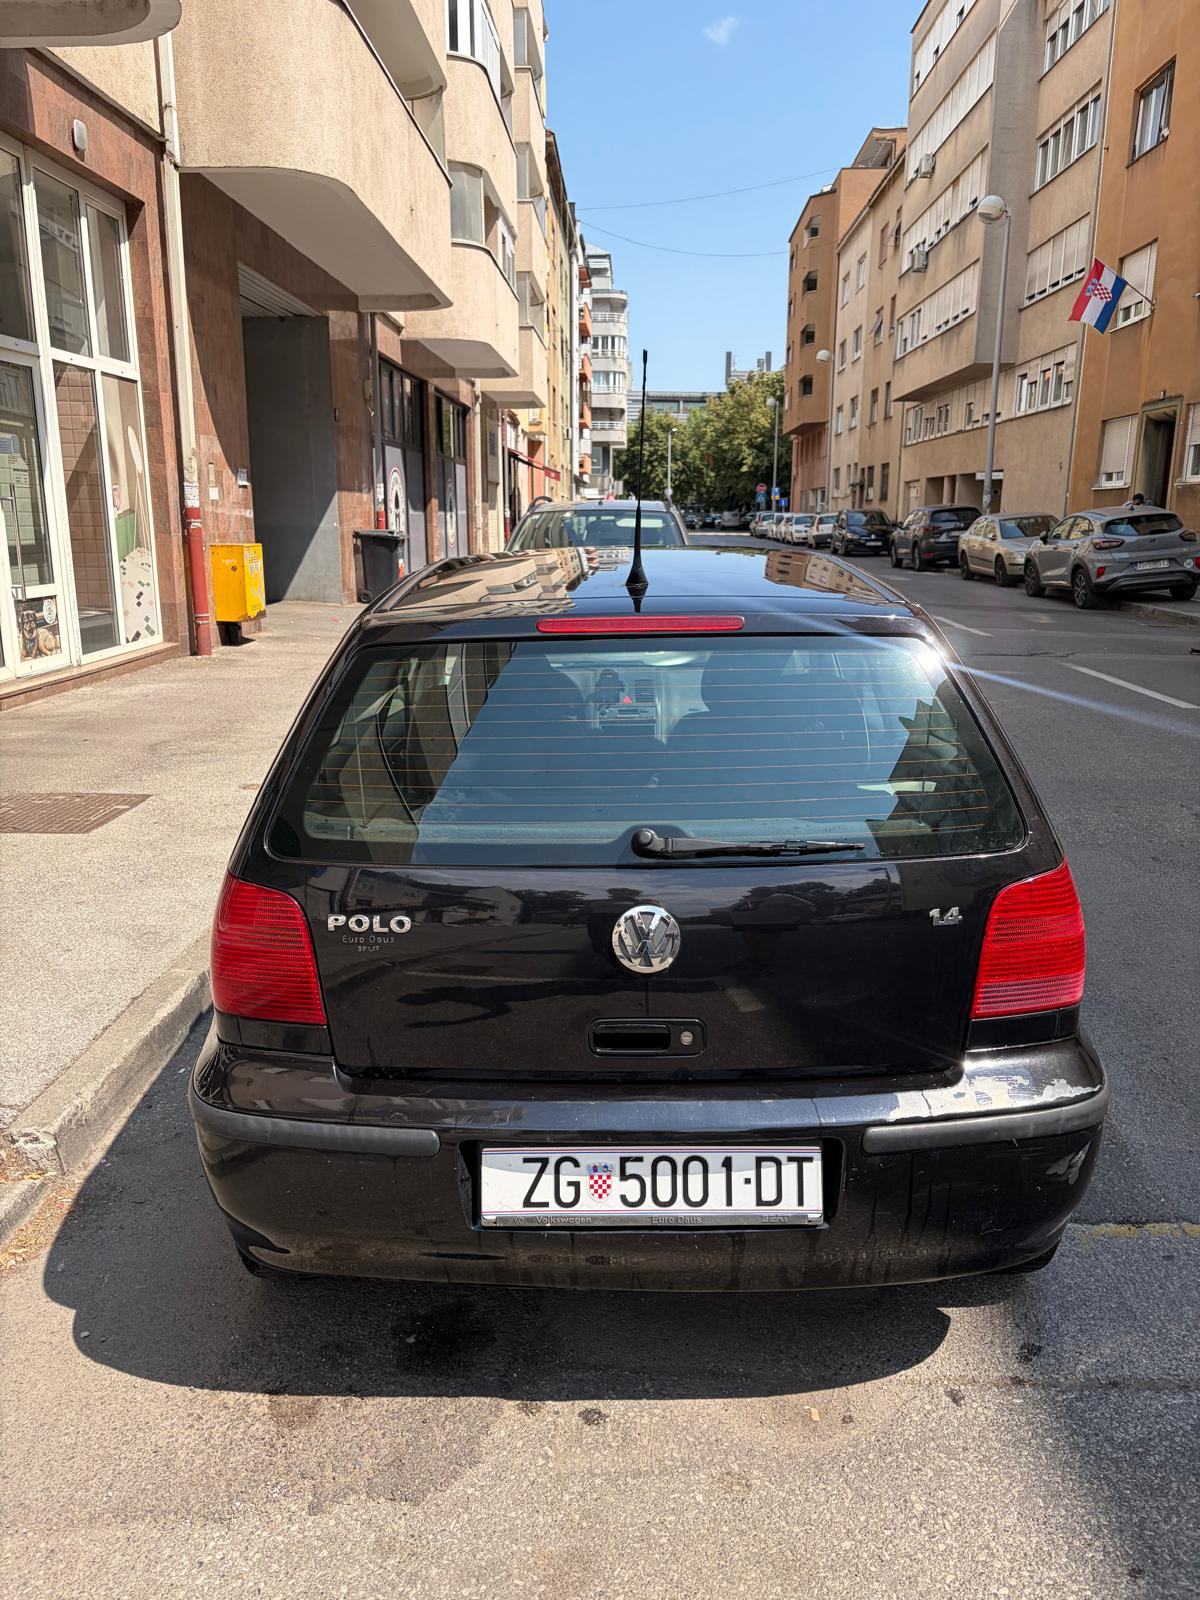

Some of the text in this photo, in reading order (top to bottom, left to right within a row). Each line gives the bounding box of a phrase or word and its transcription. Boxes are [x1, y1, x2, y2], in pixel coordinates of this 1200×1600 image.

[929, 906, 963, 926] 1.4
[327, 914, 412, 934] POLO
[342, 935, 365, 944] Euro
[522, 1156, 581, 1208] ZG
[535, 1215, 592, 1225] Volkswagen
[651, 1215, 702, 1224] Euro Daus
